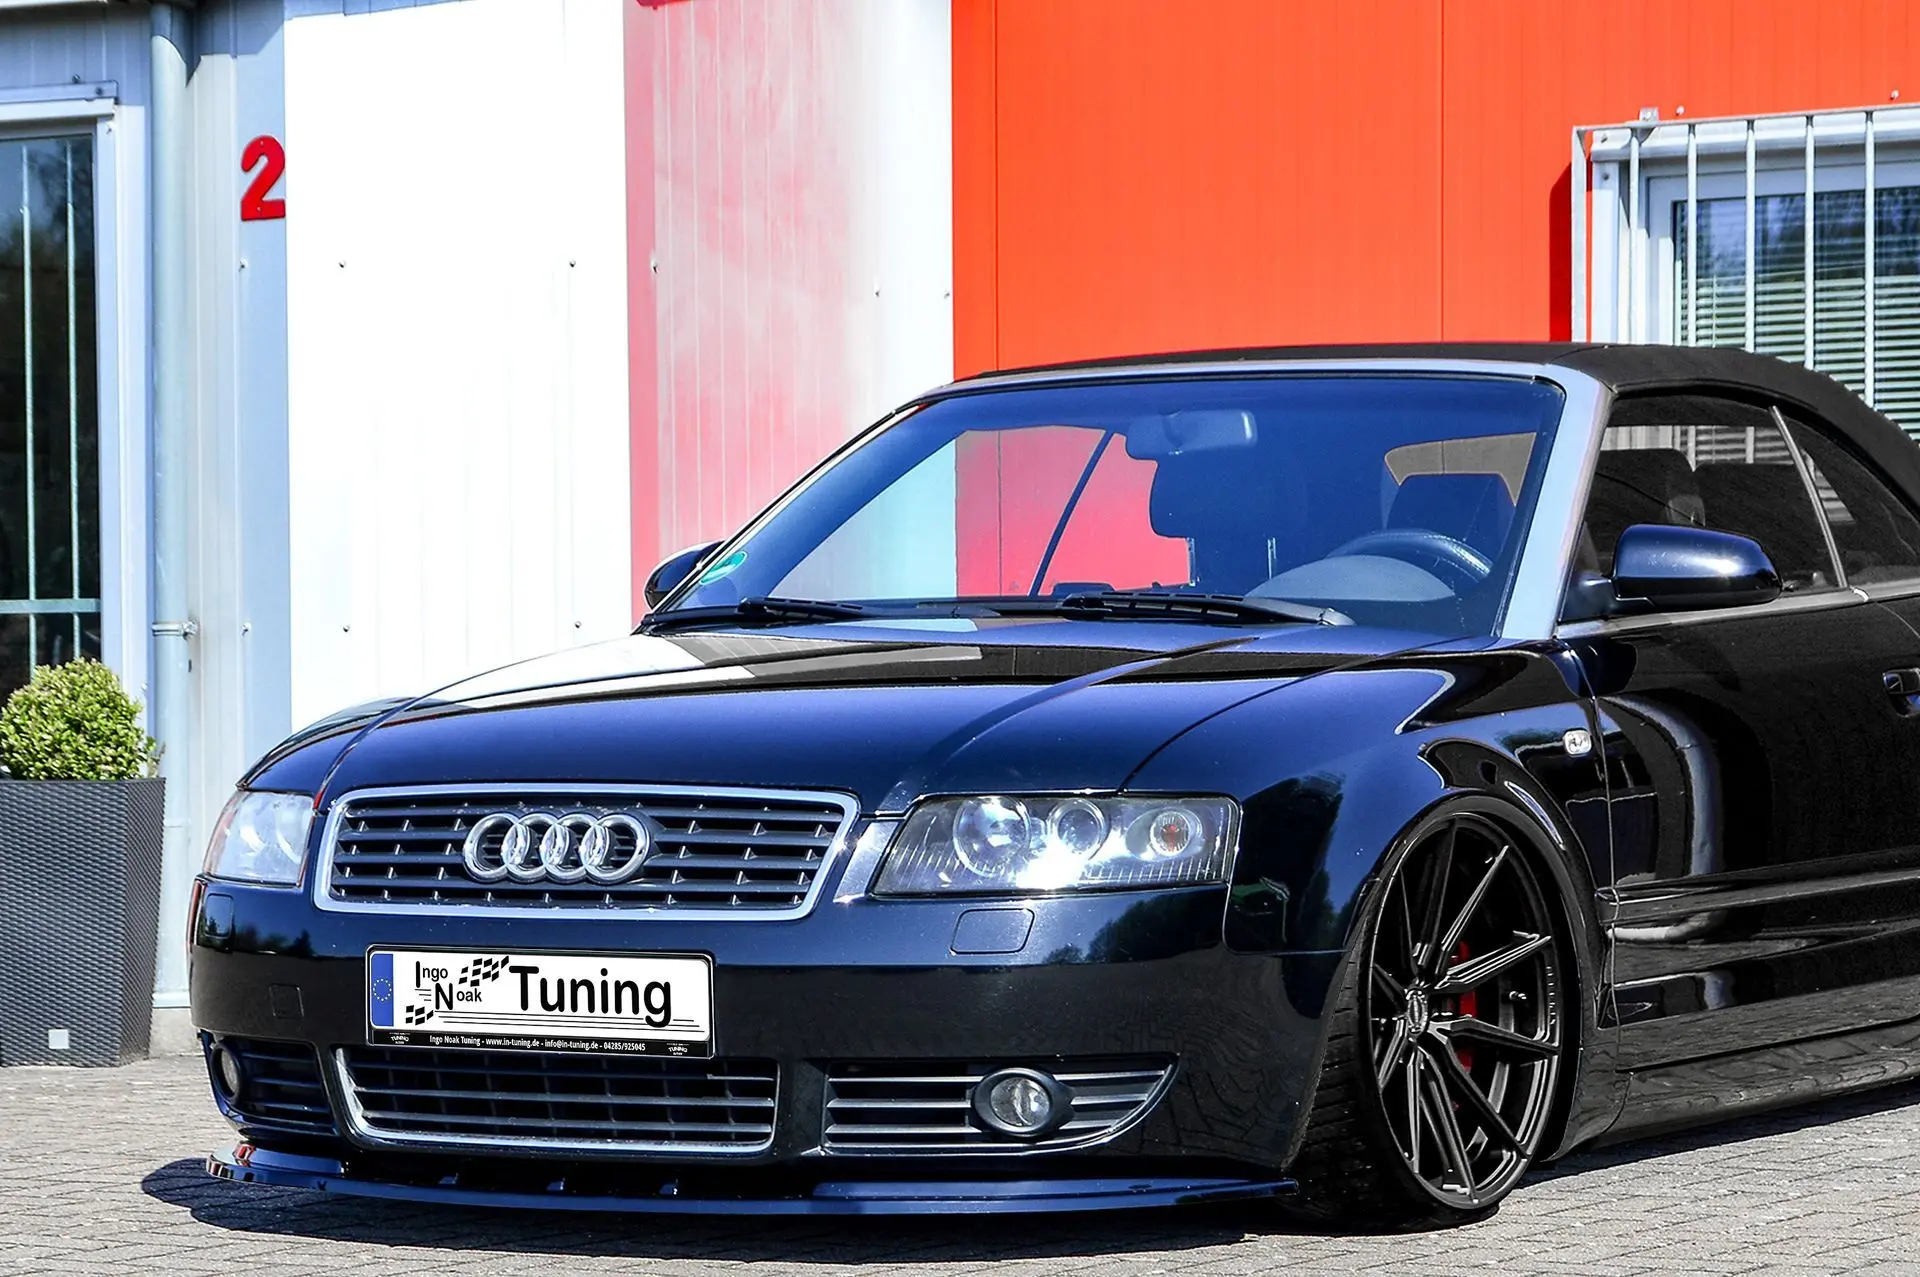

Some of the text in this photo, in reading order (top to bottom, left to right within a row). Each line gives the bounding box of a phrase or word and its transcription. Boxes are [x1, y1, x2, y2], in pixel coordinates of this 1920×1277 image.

[240, 134, 287, 222] 2
[415, 960, 449, 989] Ingo
[434, 982, 483, 1011] Noak
[508, 965, 673, 1028] Tuning
[429, 1035, 443, 1045] Ingo
[444, 1035, 460, 1044] Noak
[460, 1036, 481, 1047] Tuning
[485, 1038, 540, 1049] www.in-tuning.de
[544, 1039, 599, 1051] info@in-tuning.de
[603, 1041, 646, 1051] 04285/925045
